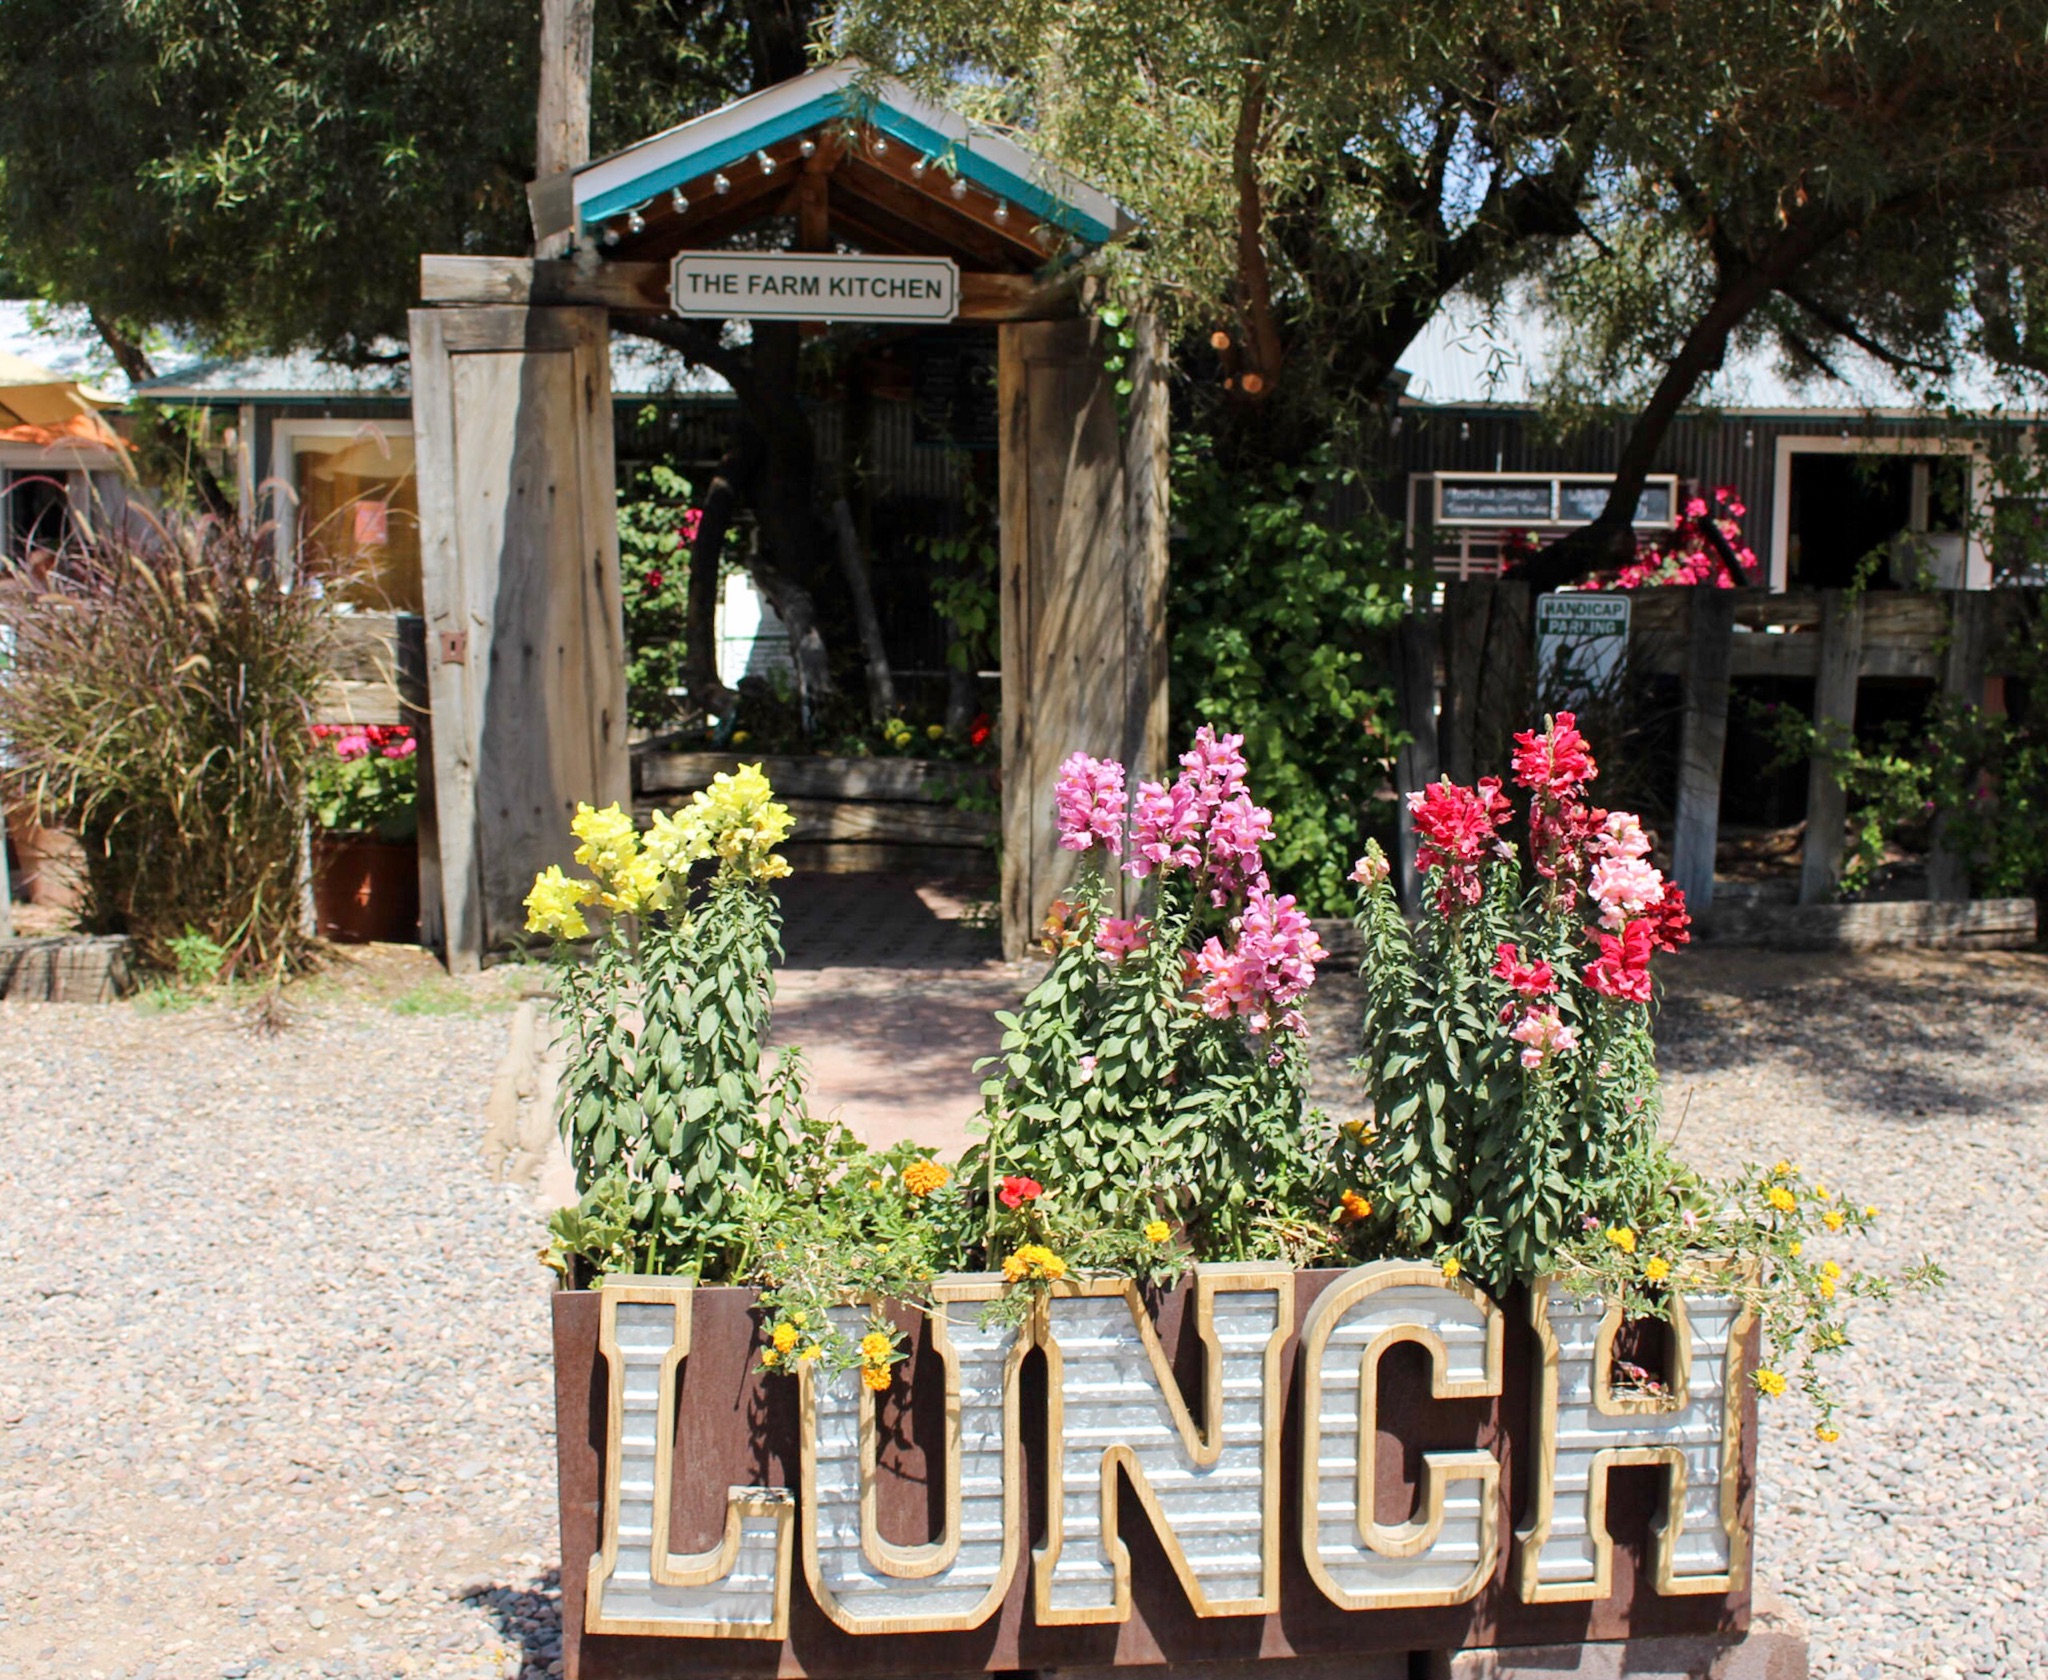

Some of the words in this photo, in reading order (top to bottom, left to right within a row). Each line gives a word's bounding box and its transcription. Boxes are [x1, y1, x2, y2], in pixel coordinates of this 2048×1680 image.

[687, 273, 738, 294] THE
[748, 275, 820, 296] FARM
[829, 278, 942, 299] KITCHEN
[1545, 603, 1622, 616] HANDICAP
[584, 1259, 1754, 1639] LUNCH
